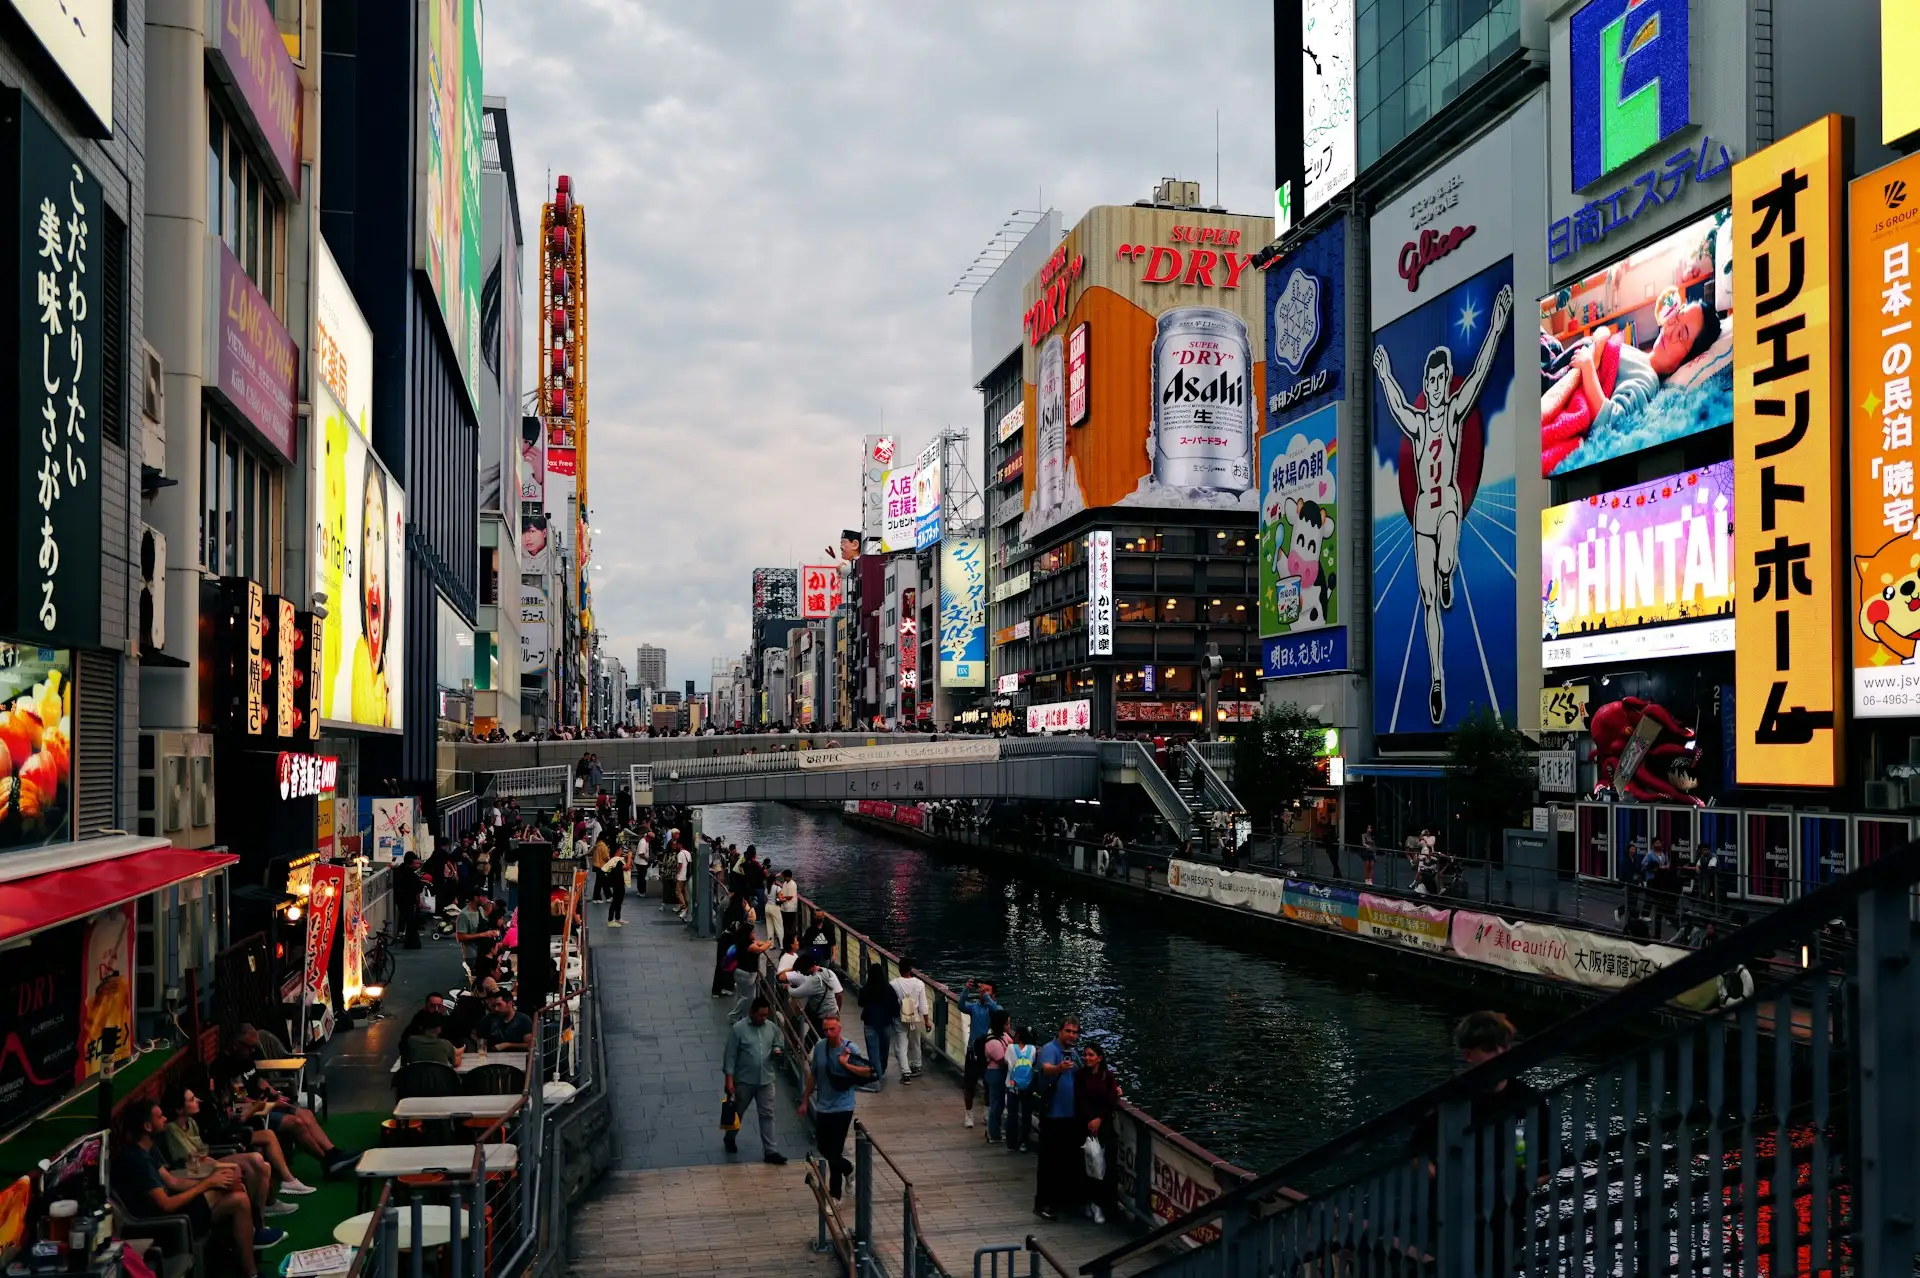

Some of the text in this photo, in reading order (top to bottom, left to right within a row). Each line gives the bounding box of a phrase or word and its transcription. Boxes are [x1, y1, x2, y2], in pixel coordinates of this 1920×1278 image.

[1549, 136, 1730, 264] 日商エステム
[1873, 208, 1918, 232] JS GROUP
[1170, 225, 1241, 247] SUPER
[1398, 225, 1477, 292] Glico
[67, 164, 87, 488] こだわりたい
[227, 272, 265, 350] LONG
[1188, 341, 1219, 349] SUPER
[226, 325, 294, 414] VIETNAM RESTAURANT
[1163, 367, 1243, 407] Asahi
[1269, 369, 1328, 413] 雪印メグミルク
[37, 197, 62, 631] 美味しさがある
[1194, 409, 1214, 424] 生
[1180, 436, 1229, 447] スーパードライ
[888, 476, 911, 498] 入店
[1272, 450, 1323, 493] 牧場の朝
[1429, 432, 1443, 509] グリコ
[1098, 551, 1109, 591] 本場の味
[1097, 594, 1110, 650] かに道楽
[311, 619, 321, 738] 串かつ
[957, 667, 968, 675] BX
[290, 753, 322, 799] 香港飯店
[1191, 875, 1214, 888] RESORTS
